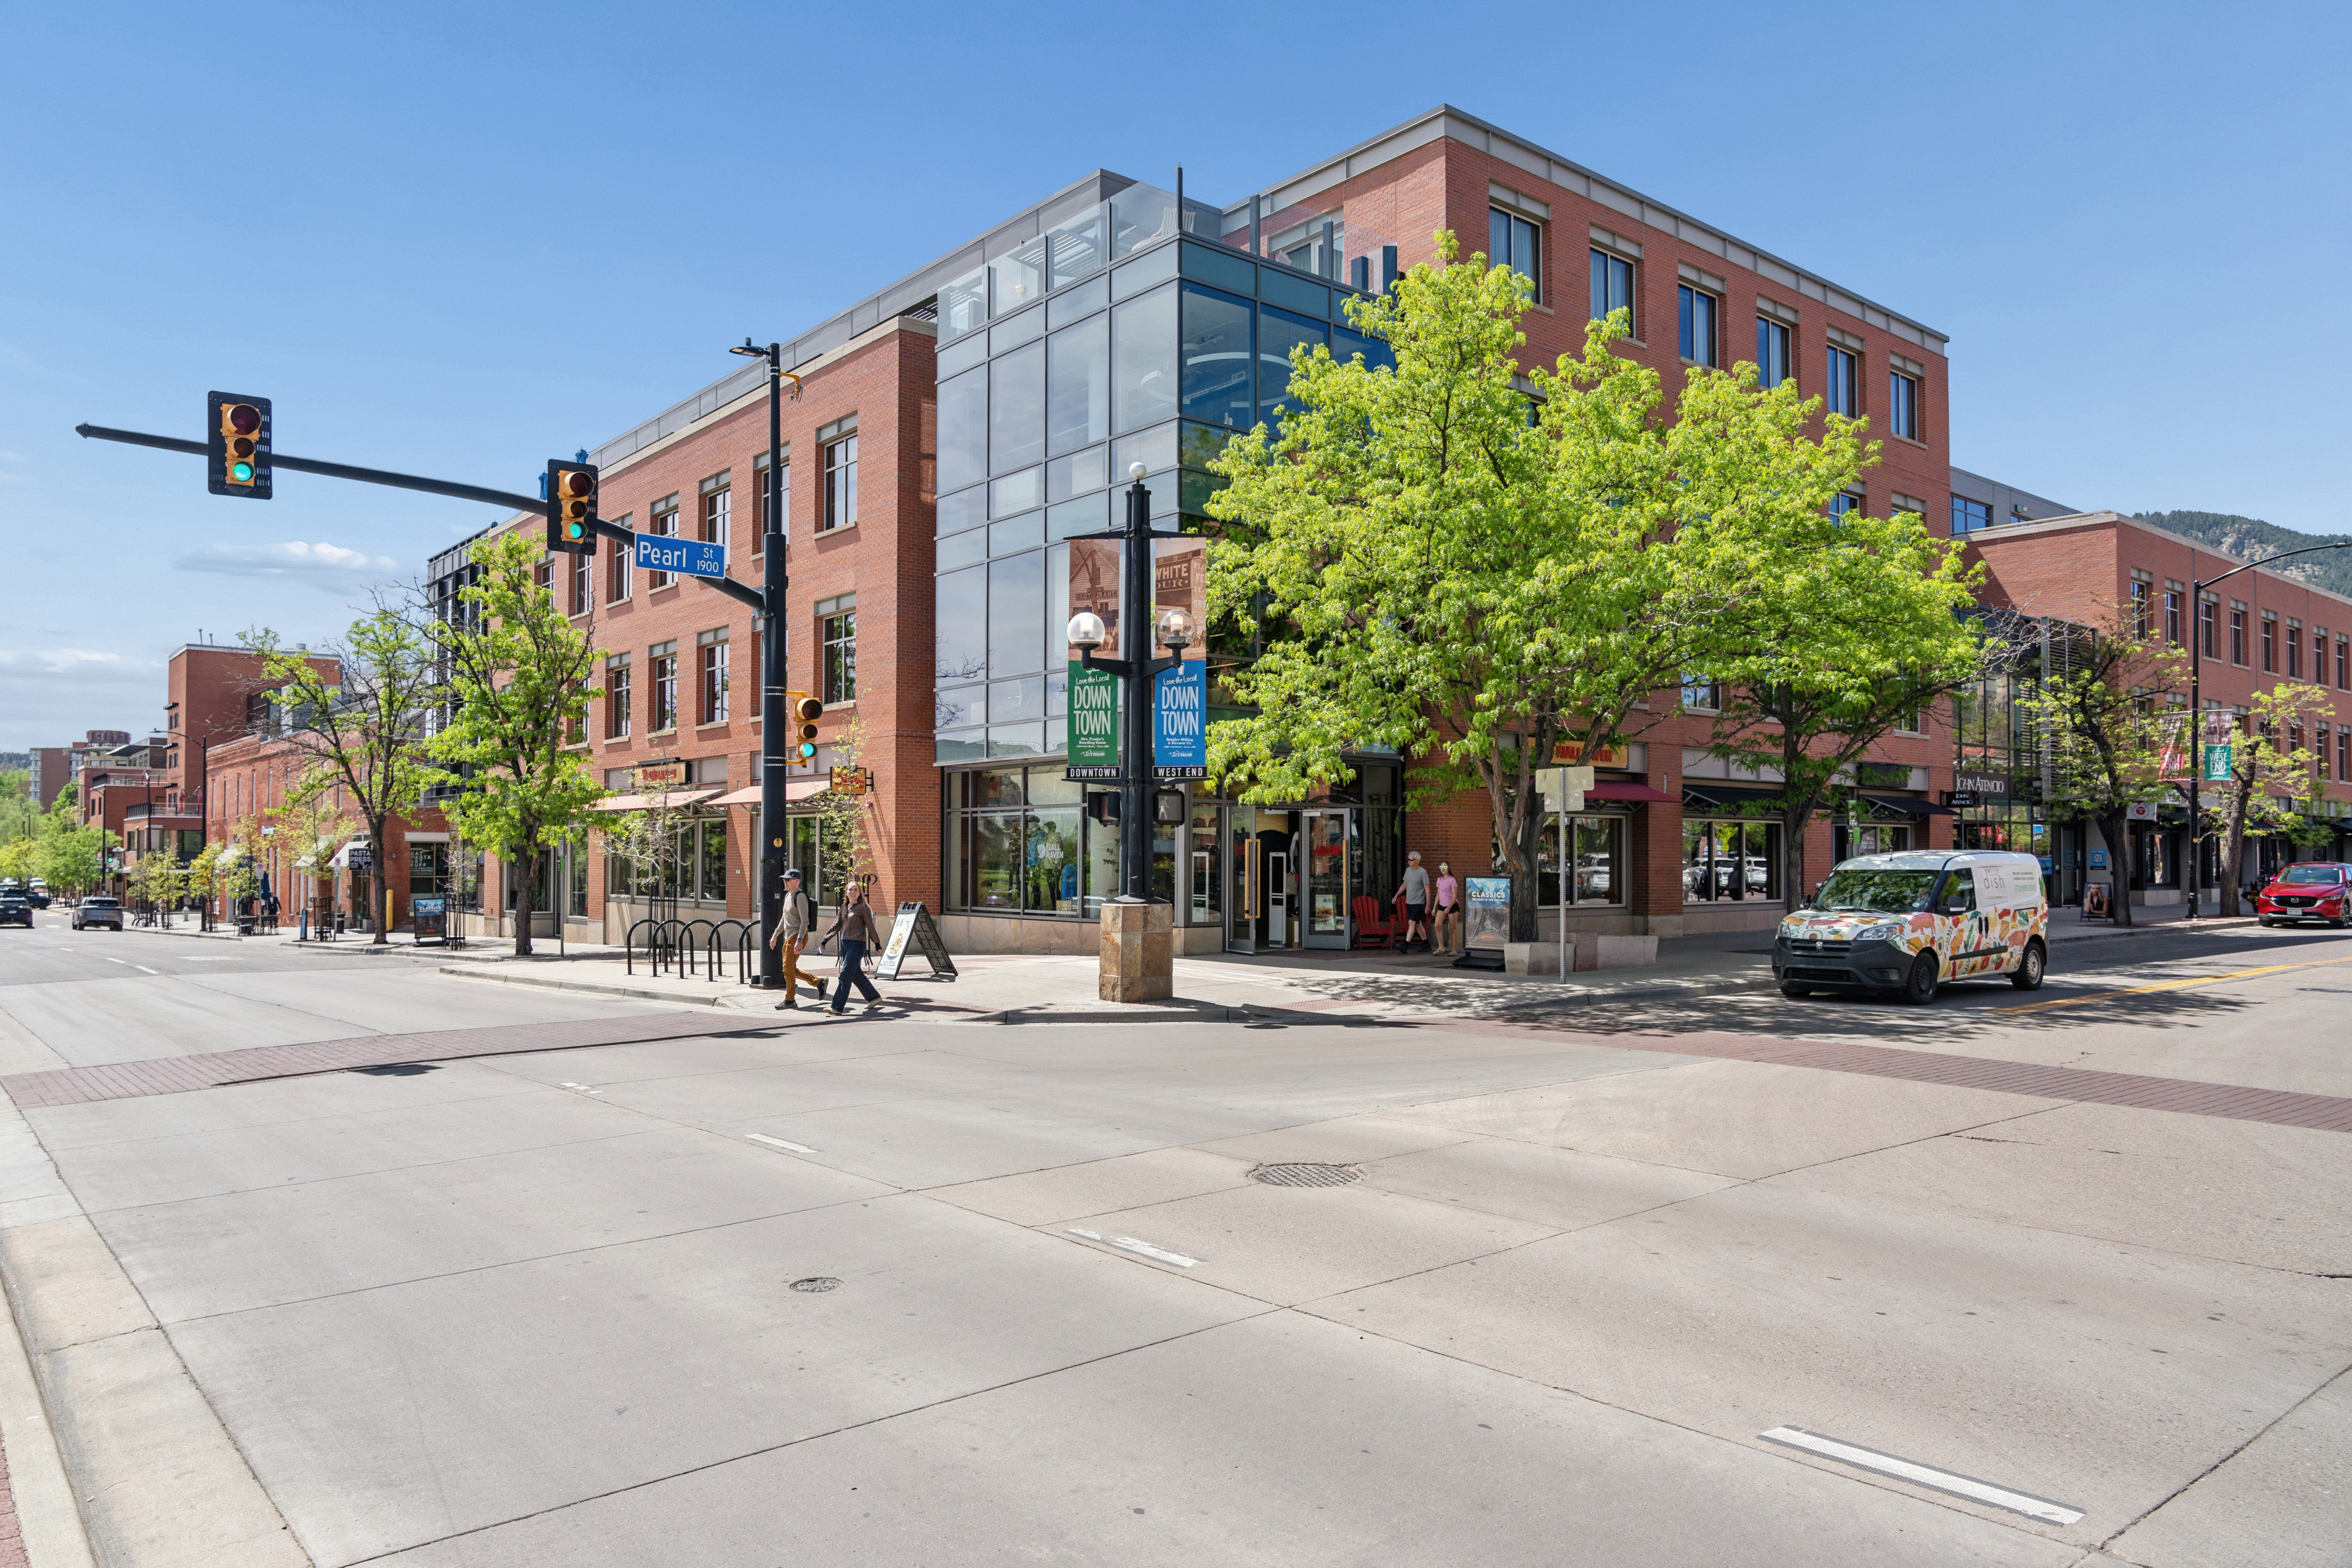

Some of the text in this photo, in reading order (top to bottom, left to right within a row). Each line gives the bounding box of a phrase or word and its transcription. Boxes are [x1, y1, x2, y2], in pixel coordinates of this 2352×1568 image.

[640, 541, 686, 567] Pearl
[703, 547, 713, 559] St
[697, 560, 719, 573] 1900
[1096, 673, 1110, 682] Local
[1184, 674, 1197, 683] Local
[1074, 686, 1111, 709] DOWN
[1162, 686, 1198, 710] DOWN
[1073, 710, 1111, 735] TOWN
[1161, 711, 1198, 735] TOWN
[2210, 753, 2227, 761] WEST
[1158, 768, 1203, 776] WEST END
[2210, 761, 2226, 771] END
[1070, 768, 1116, 777] DOWNTOWN
[1984, 868, 2005, 889] dish
